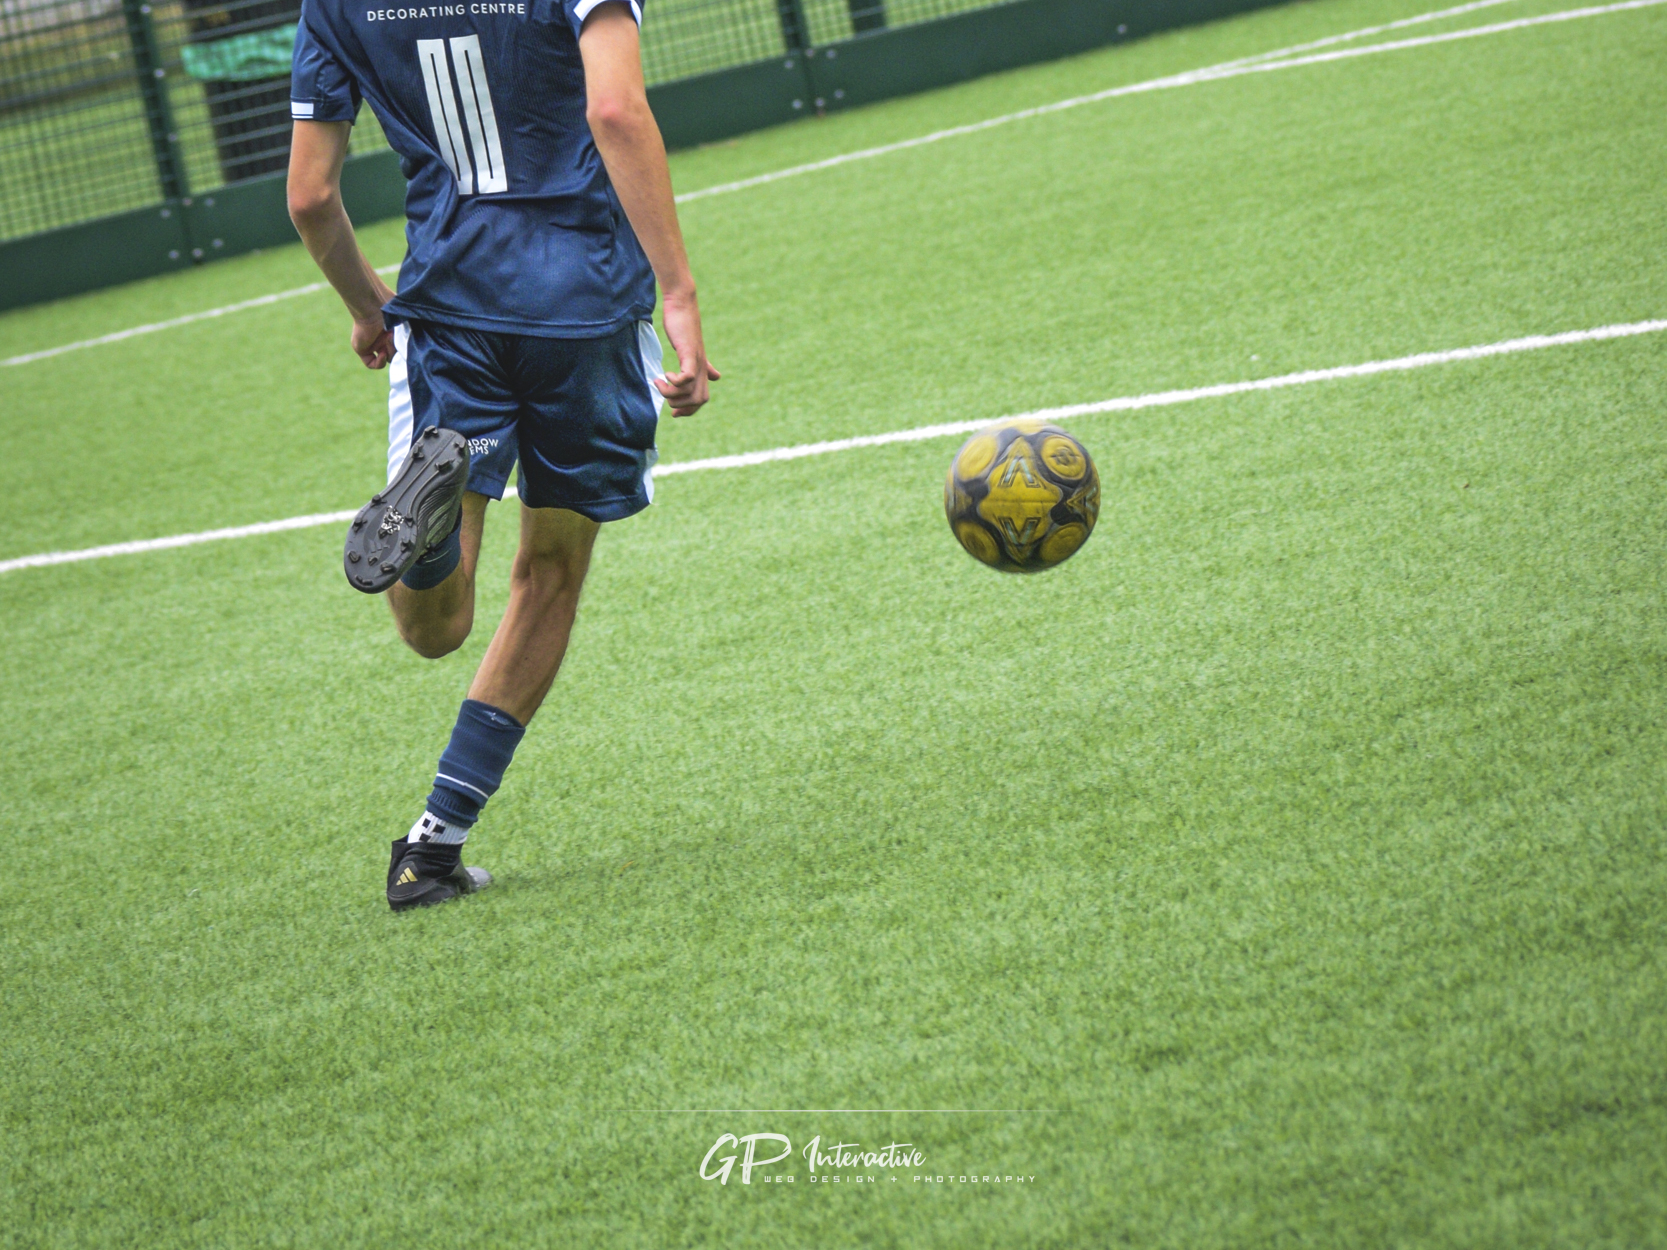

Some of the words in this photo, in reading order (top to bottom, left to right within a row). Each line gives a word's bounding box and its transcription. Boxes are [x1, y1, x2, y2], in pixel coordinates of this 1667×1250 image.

[366, 4, 466, 21] DECORATING
[470, 3, 526, 15] CENTRE
[416, 34, 508, 195] 11
